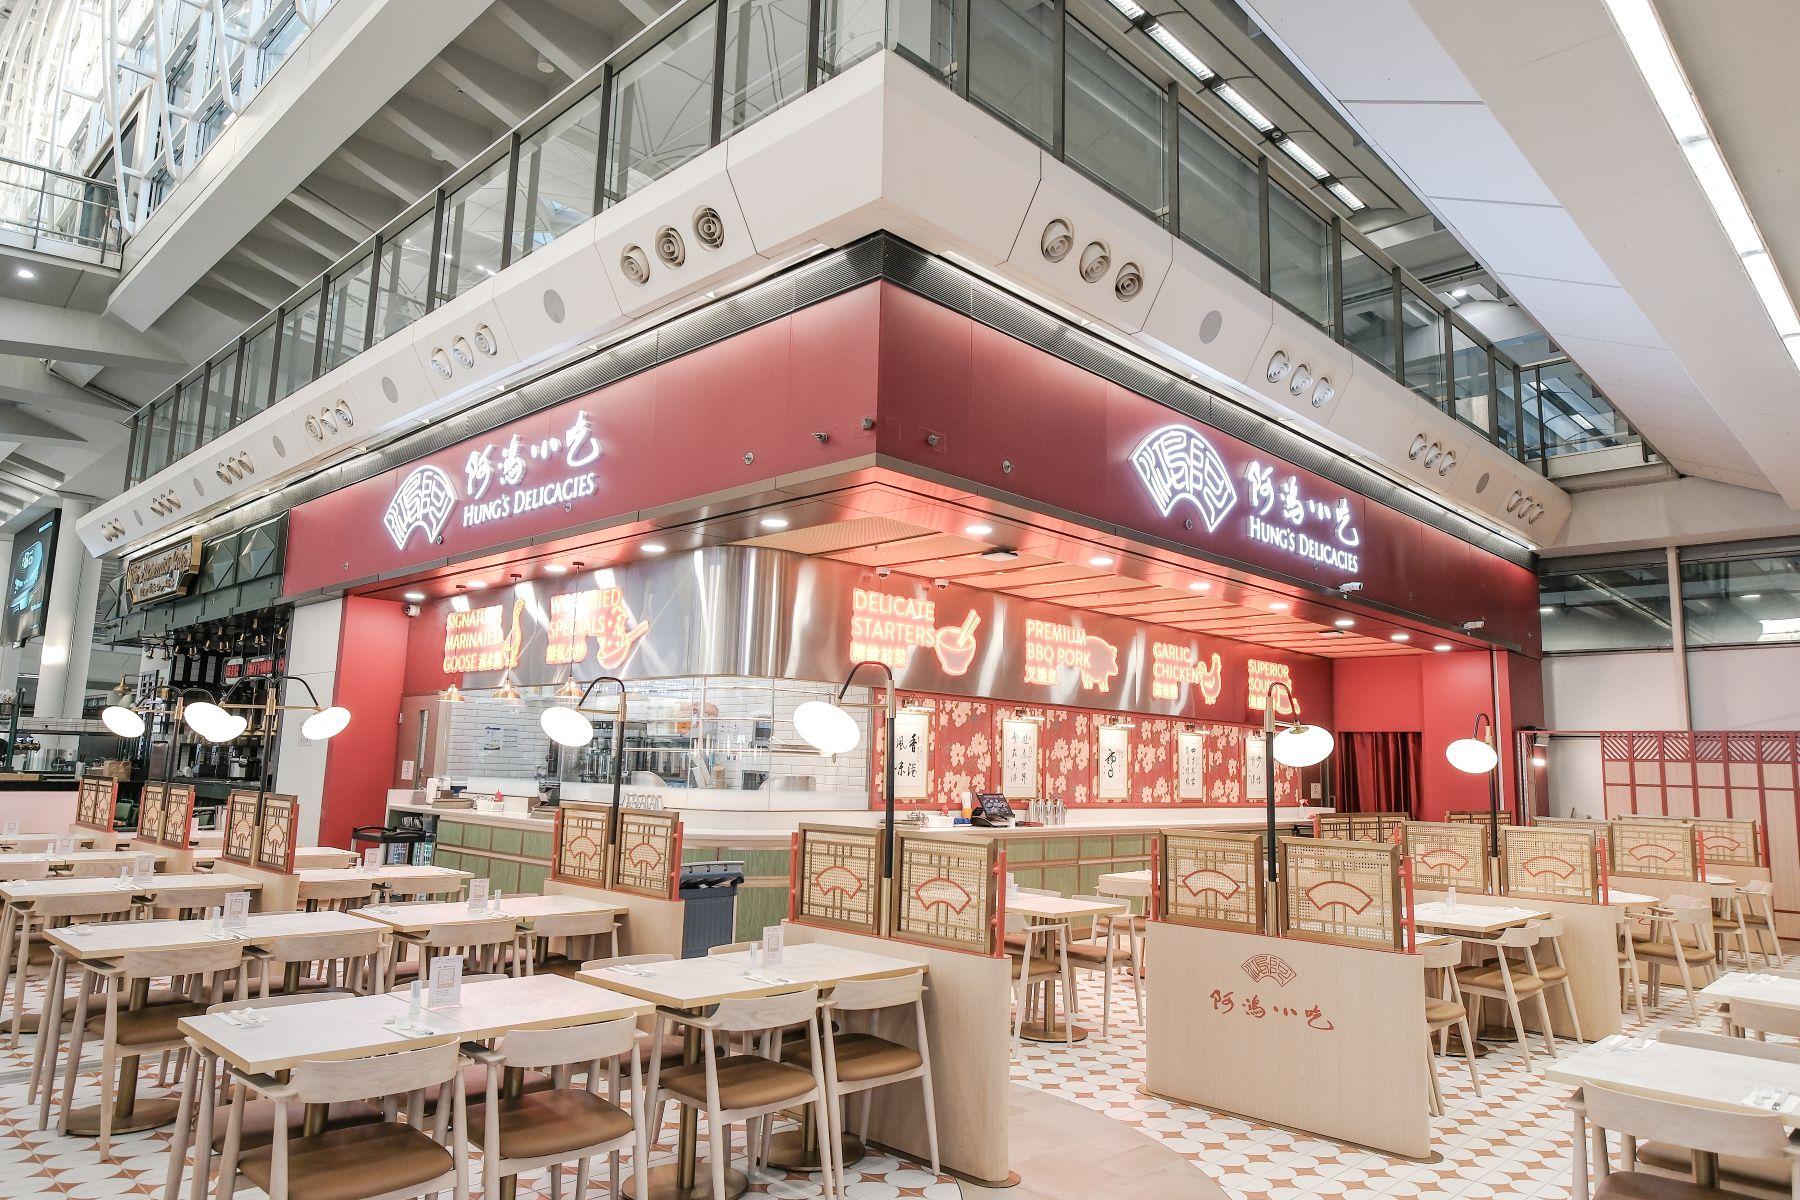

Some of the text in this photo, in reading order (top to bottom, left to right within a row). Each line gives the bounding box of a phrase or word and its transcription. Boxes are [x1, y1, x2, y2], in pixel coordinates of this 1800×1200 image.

[513, 472, 597, 514] DELICACIES
[1300, 533, 1359, 573] DELICACIES
[855, 590, 935, 622] DELICATE
[853, 617, 935, 645] STARTERS
[1027, 621, 1087, 645] PREMIUM
[444, 654, 477, 672] GOOSE
[1027, 643, 1091, 668] BBQ PORK
[1154, 643, 1191, 662] GARLIC
[1154, 663, 1199, 684] CHICKEN
[1249, 660, 1289, 679] SUPERIOR
